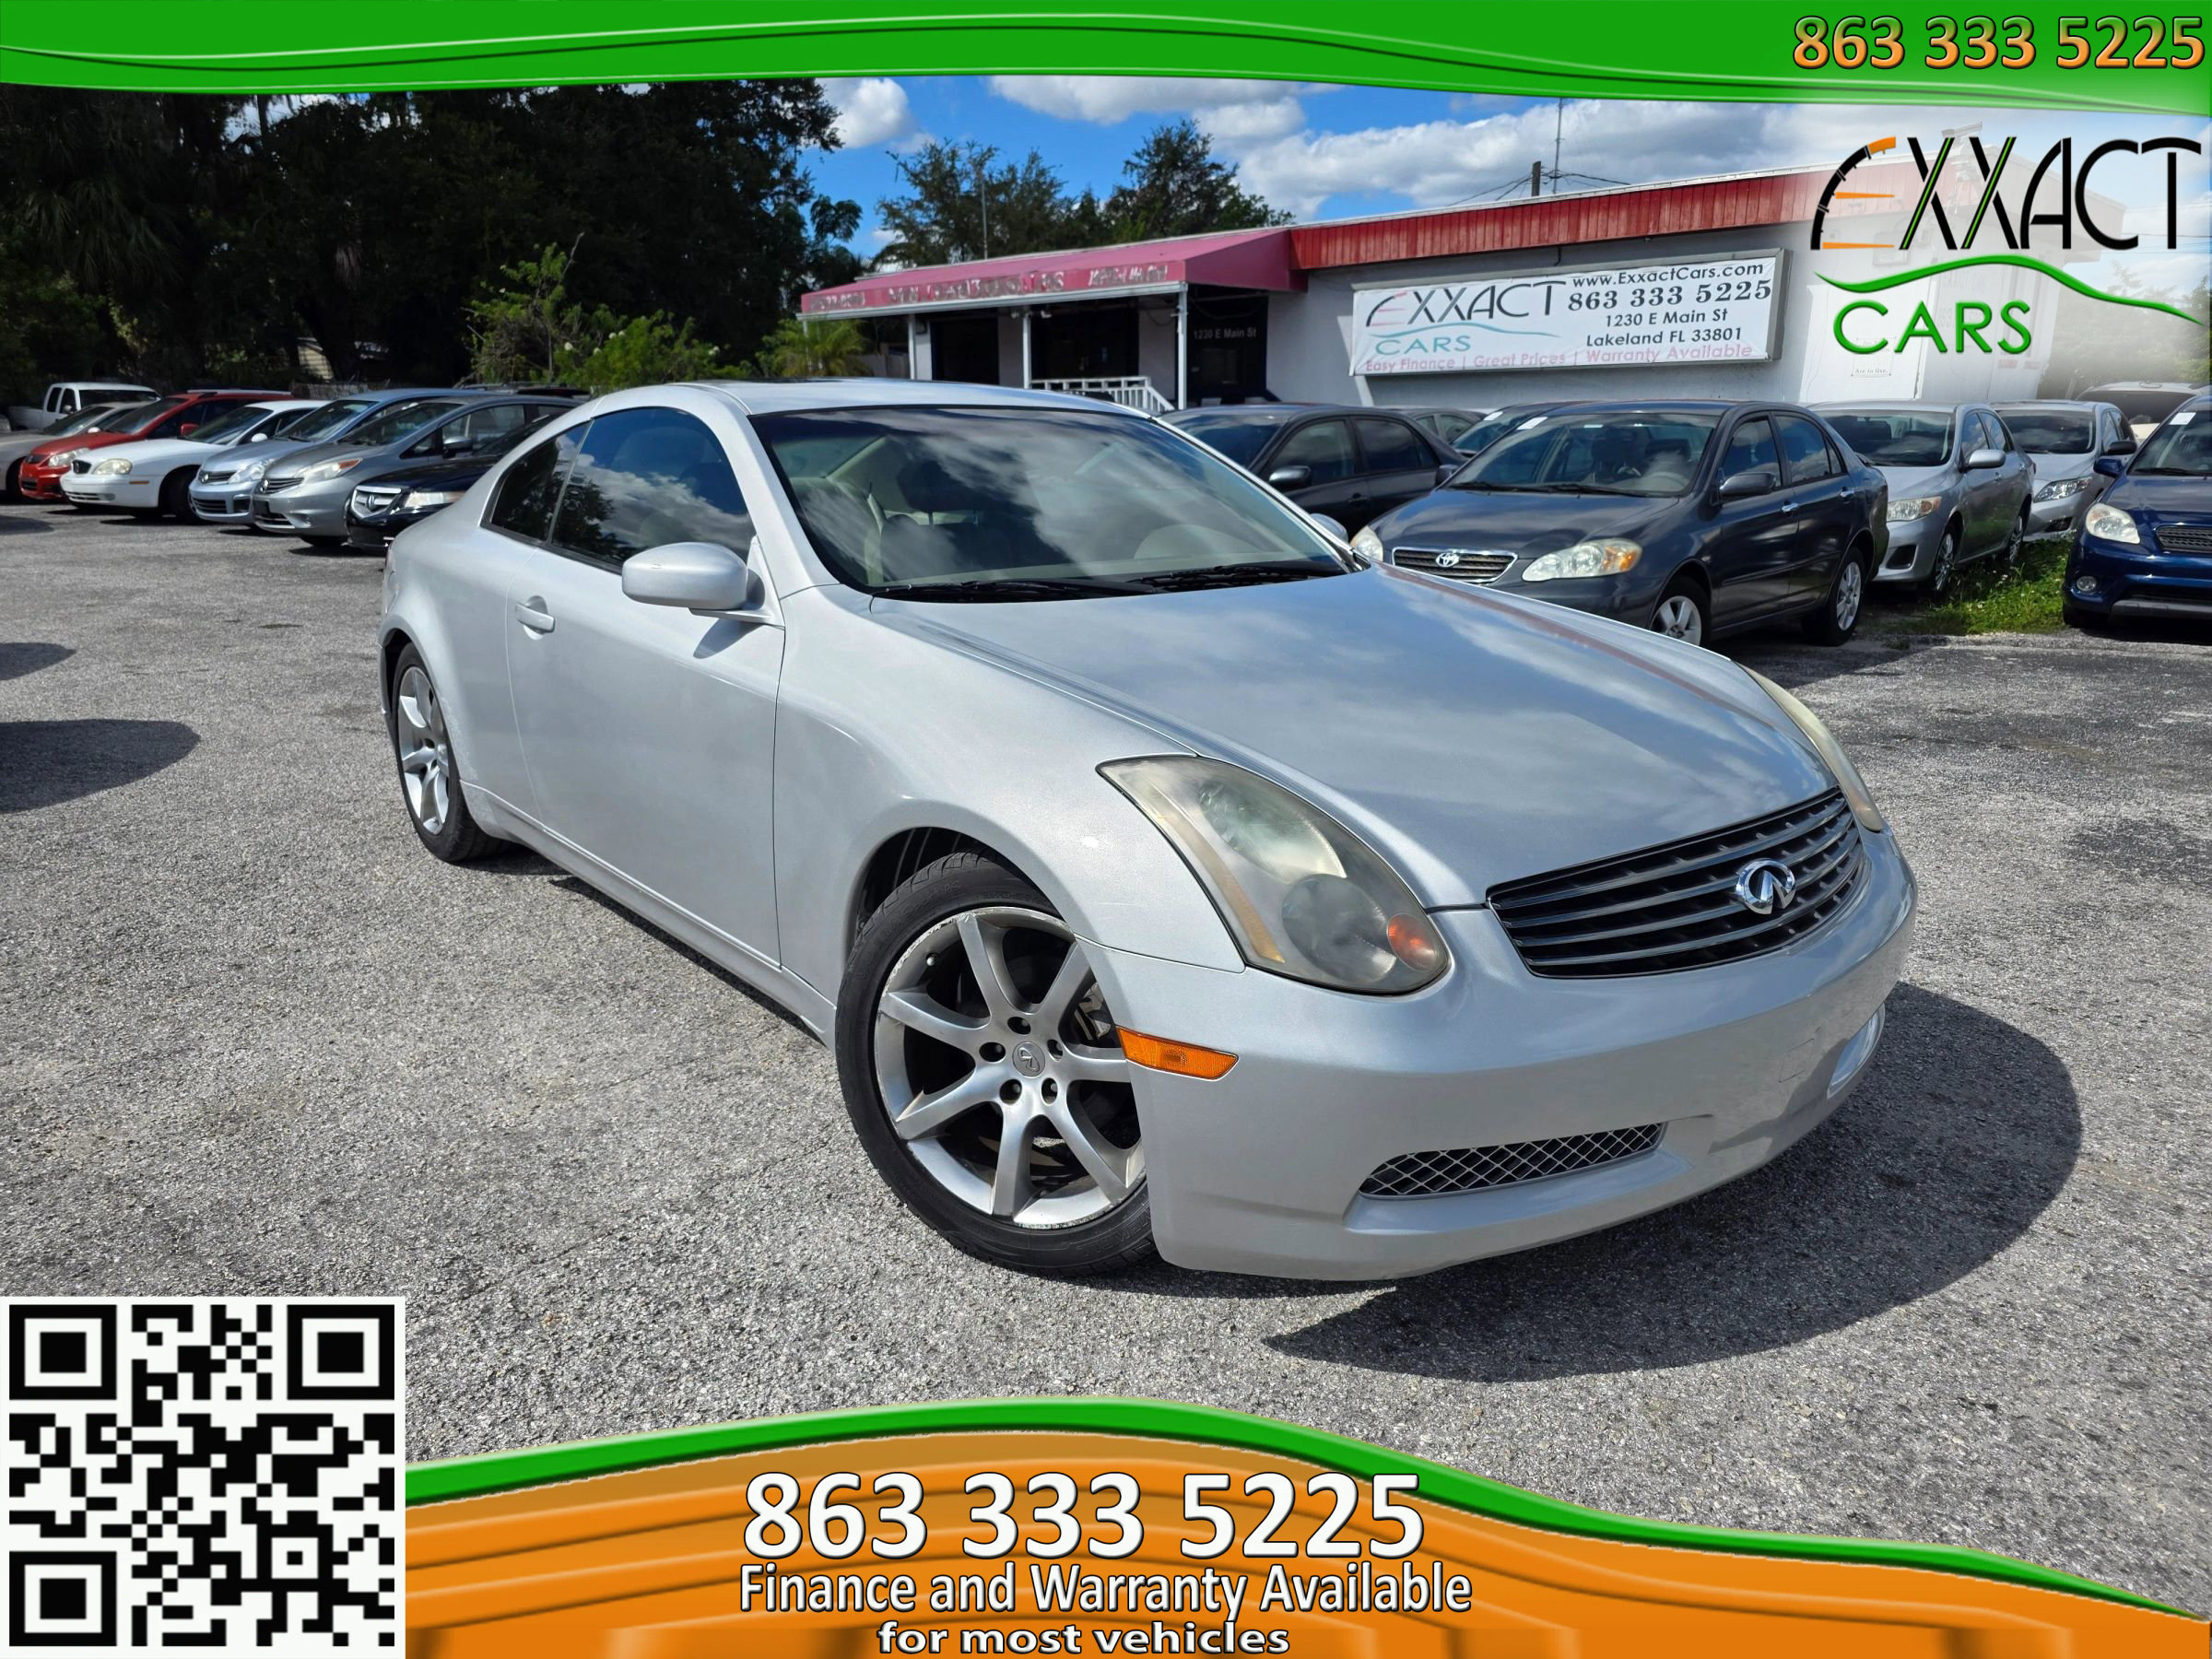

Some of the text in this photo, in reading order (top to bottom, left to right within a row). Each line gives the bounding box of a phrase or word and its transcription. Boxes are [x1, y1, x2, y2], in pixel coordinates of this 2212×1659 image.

[1572, 264, 1764, 288] www.ExxactCars.com
[1365, 281, 1566, 327] EXXACT
[1568, 279, 1772, 312] 863 333 5225
[1606, 308, 1728, 327] 1230 E Main St
[1215, 328, 1221, 339] E
[1224, 328, 1245, 339] Main
[1586, 327, 1742, 347] Lakeland FL 33801
[1375, 335, 1472, 356] CARS
[1366, 359, 1396, 373] Easy
[1400, 357, 1455, 371] Finance
[1475, 354, 1516, 369] Great
[1521, 352, 1566, 368] Prices
[1586, 348, 1660, 364] Warranty
[1666, 344, 1753, 360] Available
